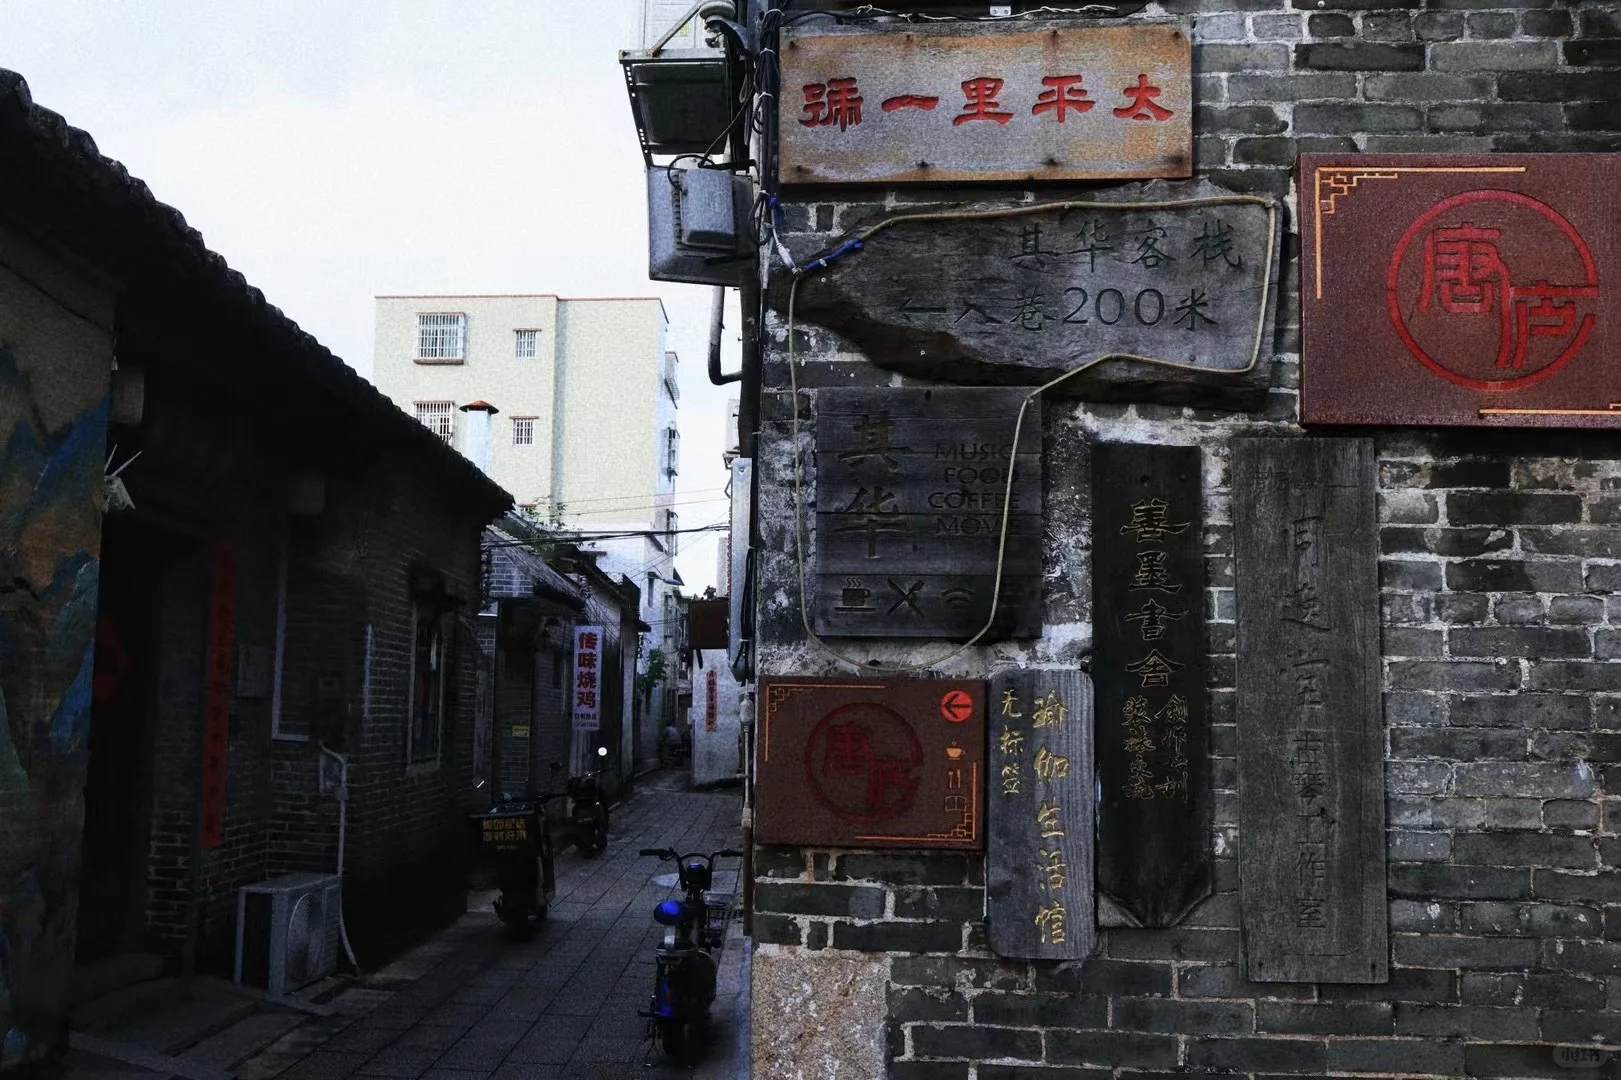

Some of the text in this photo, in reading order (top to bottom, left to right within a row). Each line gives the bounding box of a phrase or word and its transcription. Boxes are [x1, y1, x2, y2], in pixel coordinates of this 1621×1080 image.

[1008, 219, 1244, 273] 其华客栈
[934, 442, 1014, 461] MUSIC
[944, 467, 1020, 484] FOOD
[927, 491, 1021, 509] COFFEE
[1032, 689, 1069, 945] 瑜伽生活馆
